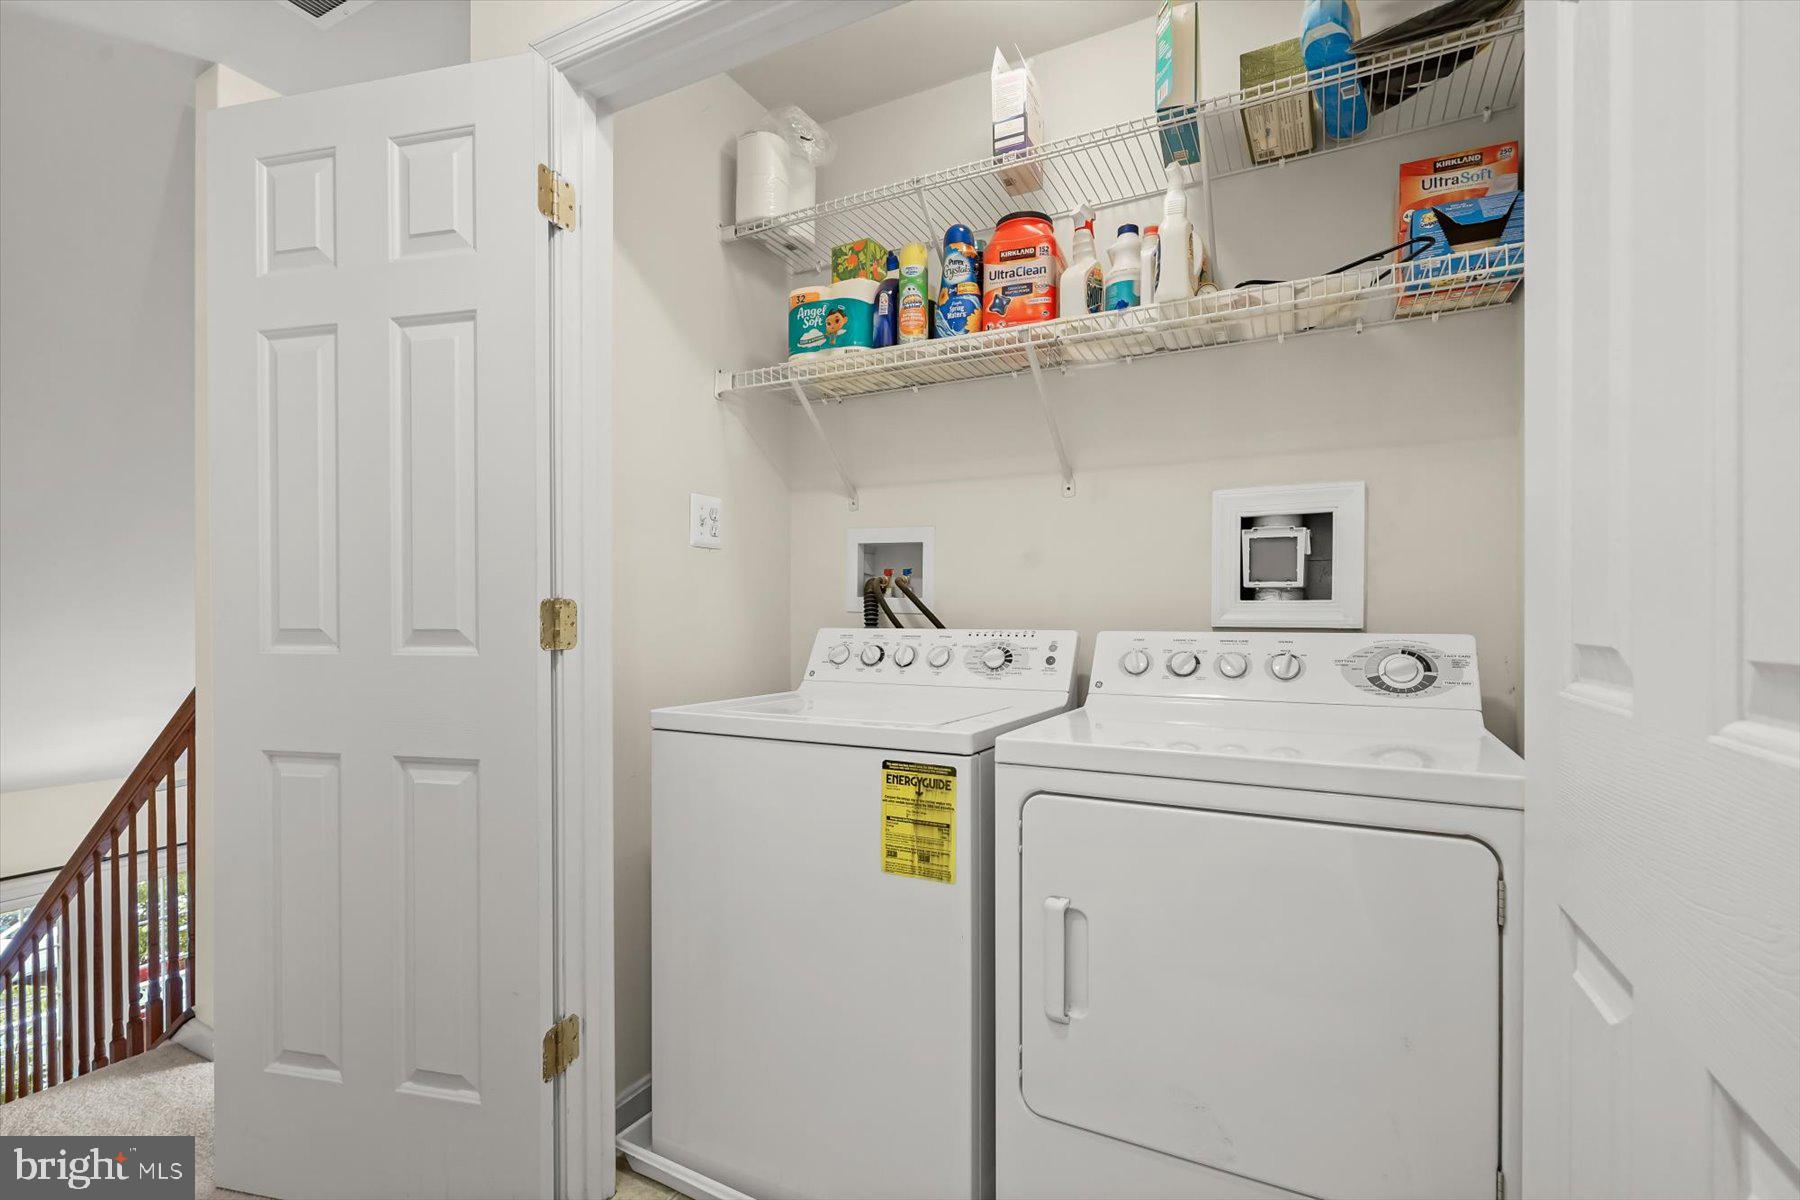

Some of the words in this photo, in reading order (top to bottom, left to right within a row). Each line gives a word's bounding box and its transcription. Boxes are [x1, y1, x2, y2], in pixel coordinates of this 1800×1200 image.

[1435, 154, 1482, 168] KIRKLAND
[1421, 168, 1493, 191] UltraSoft
[1000, 247, 1035, 258] KIRKLAND
[1039, 245, 1050, 253] 152
[989, 266, 1047, 281] UltraClean
[796, 294, 806, 304] 32
[797, 304, 827, 320] Angel
[803, 315, 823, 328] Soft
[886, 774, 952, 791] ENERGYGUIDE
